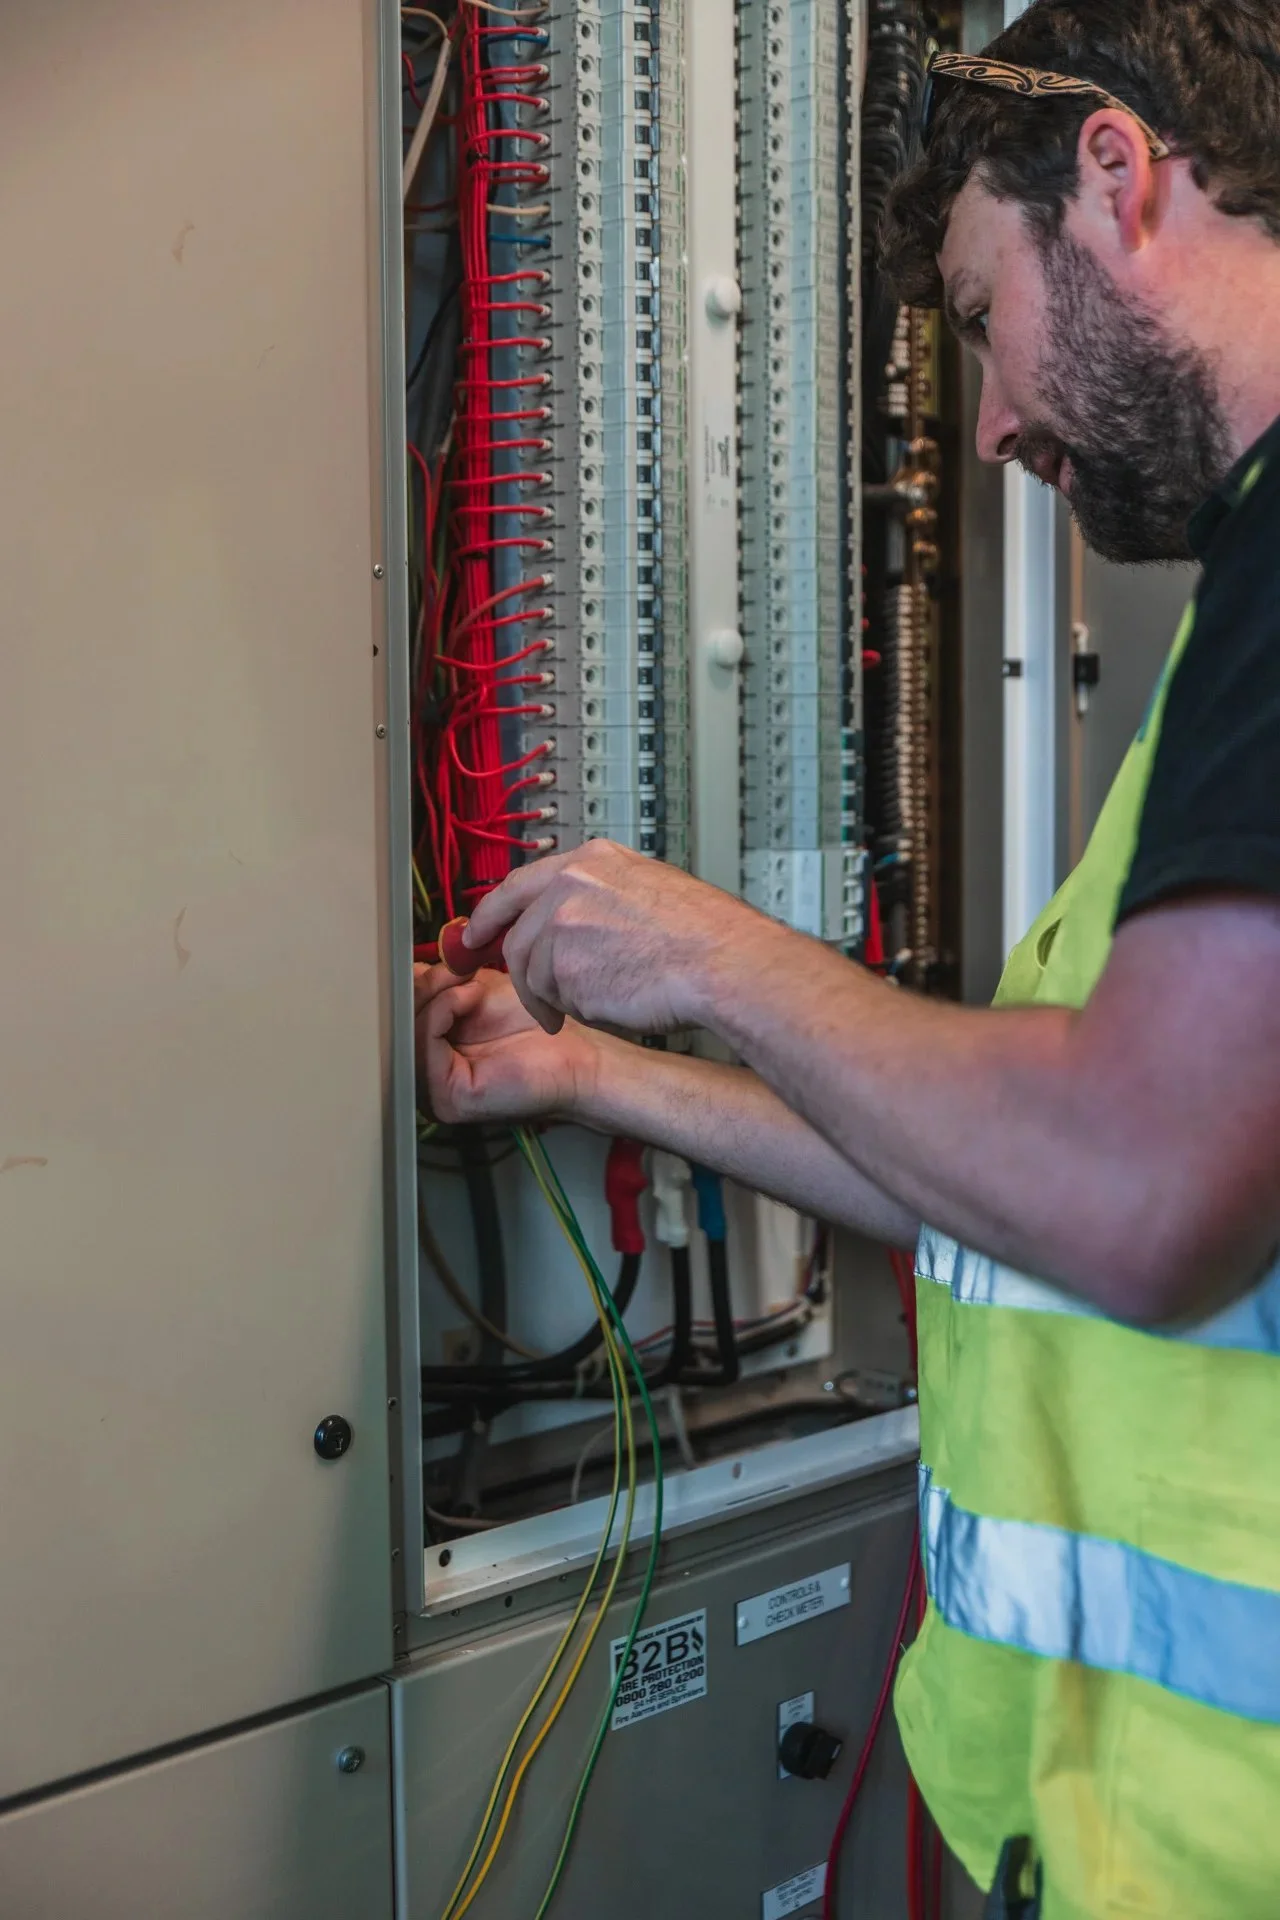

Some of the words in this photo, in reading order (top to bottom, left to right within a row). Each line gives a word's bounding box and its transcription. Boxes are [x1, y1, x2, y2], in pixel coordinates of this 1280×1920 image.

[615, 1631, 689, 1681] B2B
[641, 1655, 705, 1685] PROTECTION
[615, 1687, 647, 1708] 0800
[649, 1678, 672, 1695] 280
[674, 1666, 704, 1684] 4200
[658, 1684, 687, 1701] SERVICE
[630, 1705, 656, 1719] Alarms
